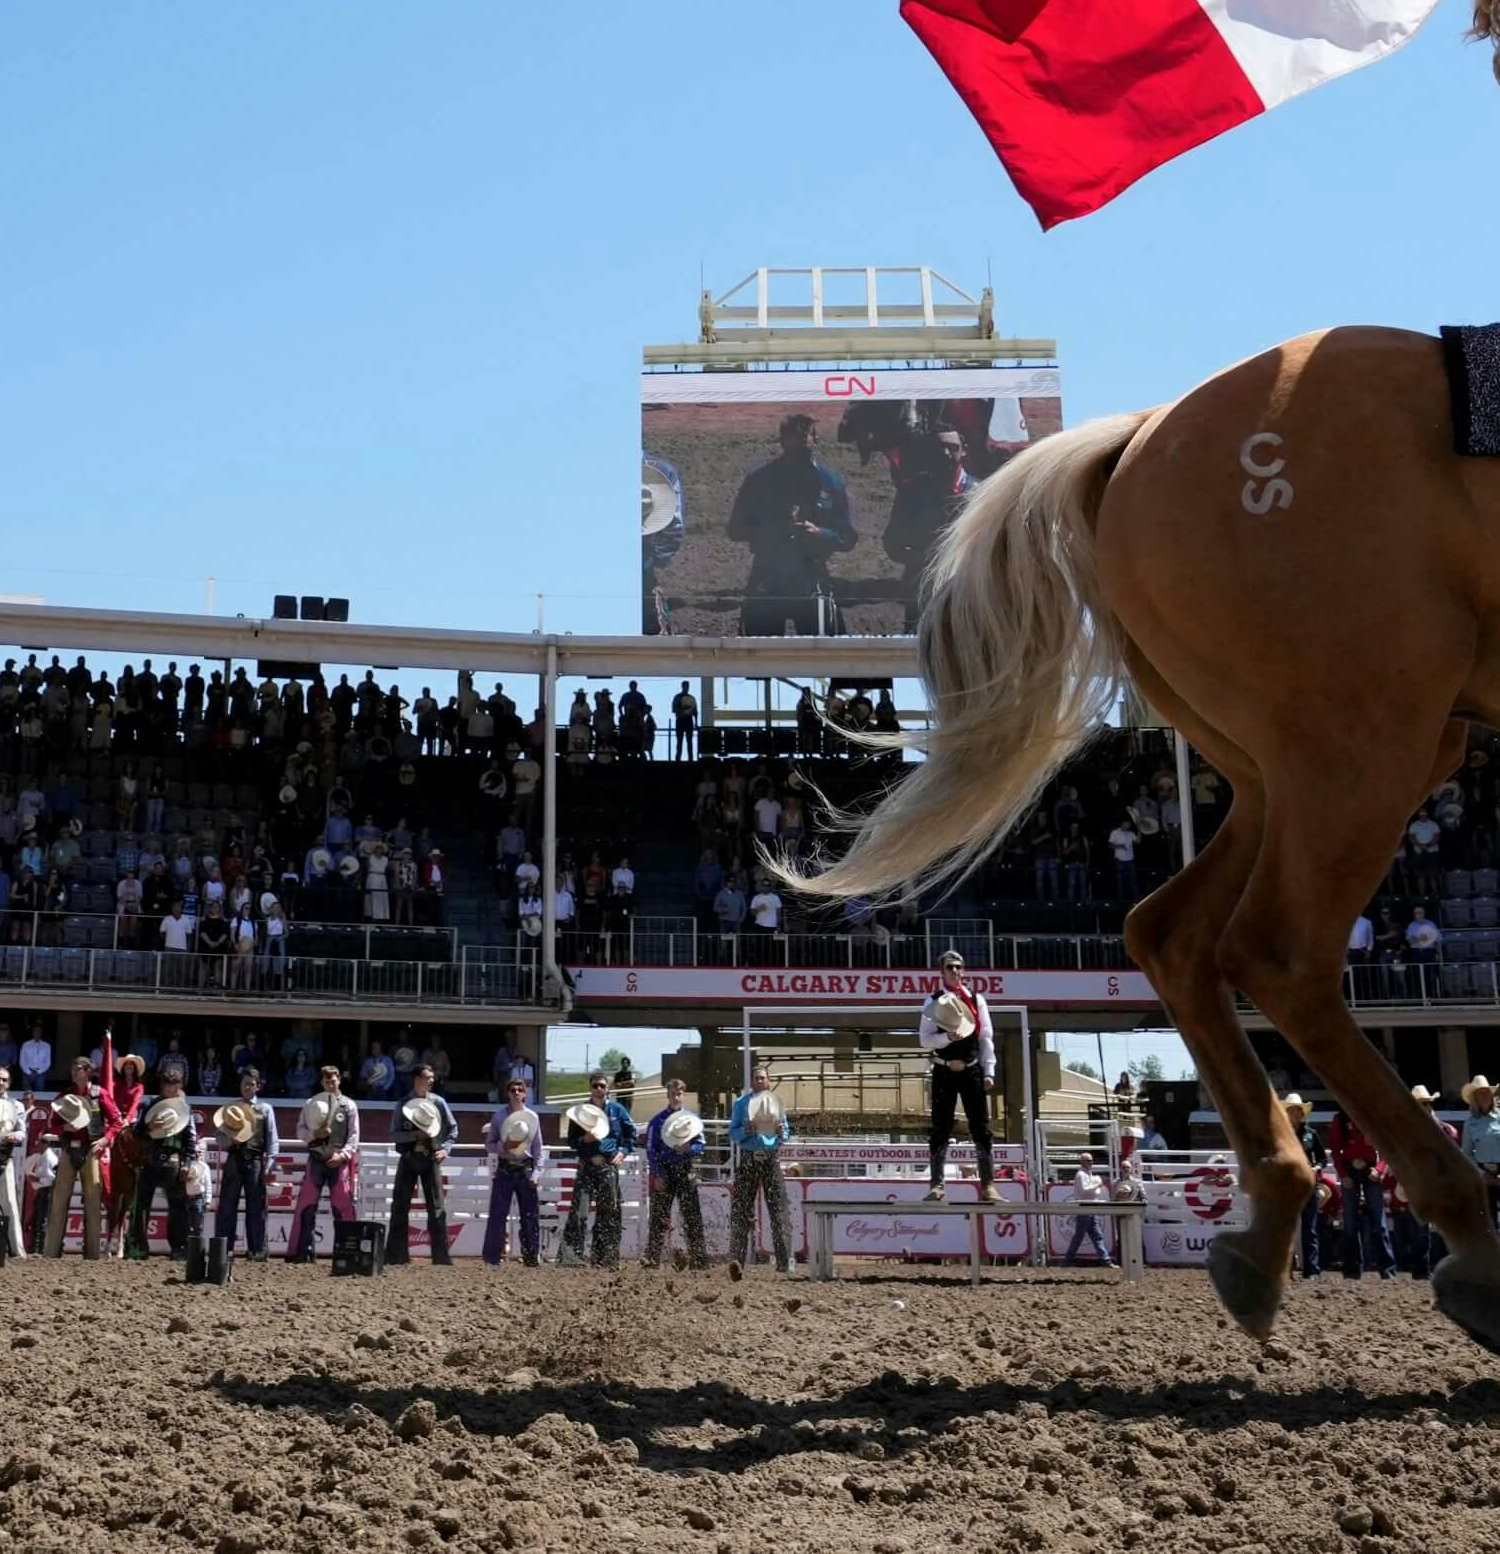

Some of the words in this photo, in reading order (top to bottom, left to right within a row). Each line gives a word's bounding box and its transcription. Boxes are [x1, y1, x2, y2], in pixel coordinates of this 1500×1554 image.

[825, 376, 875, 396] CN
[740, 974, 860, 994] CALGARY
[866, 974, 1004, 994] STAMEDE
[779, 1148, 795, 1158] HE
[859, 1149, 912, 1159] OUTDOOR
[950, 1149, 966, 1159] ON
[970, 1149, 1008, 1159] ETH
